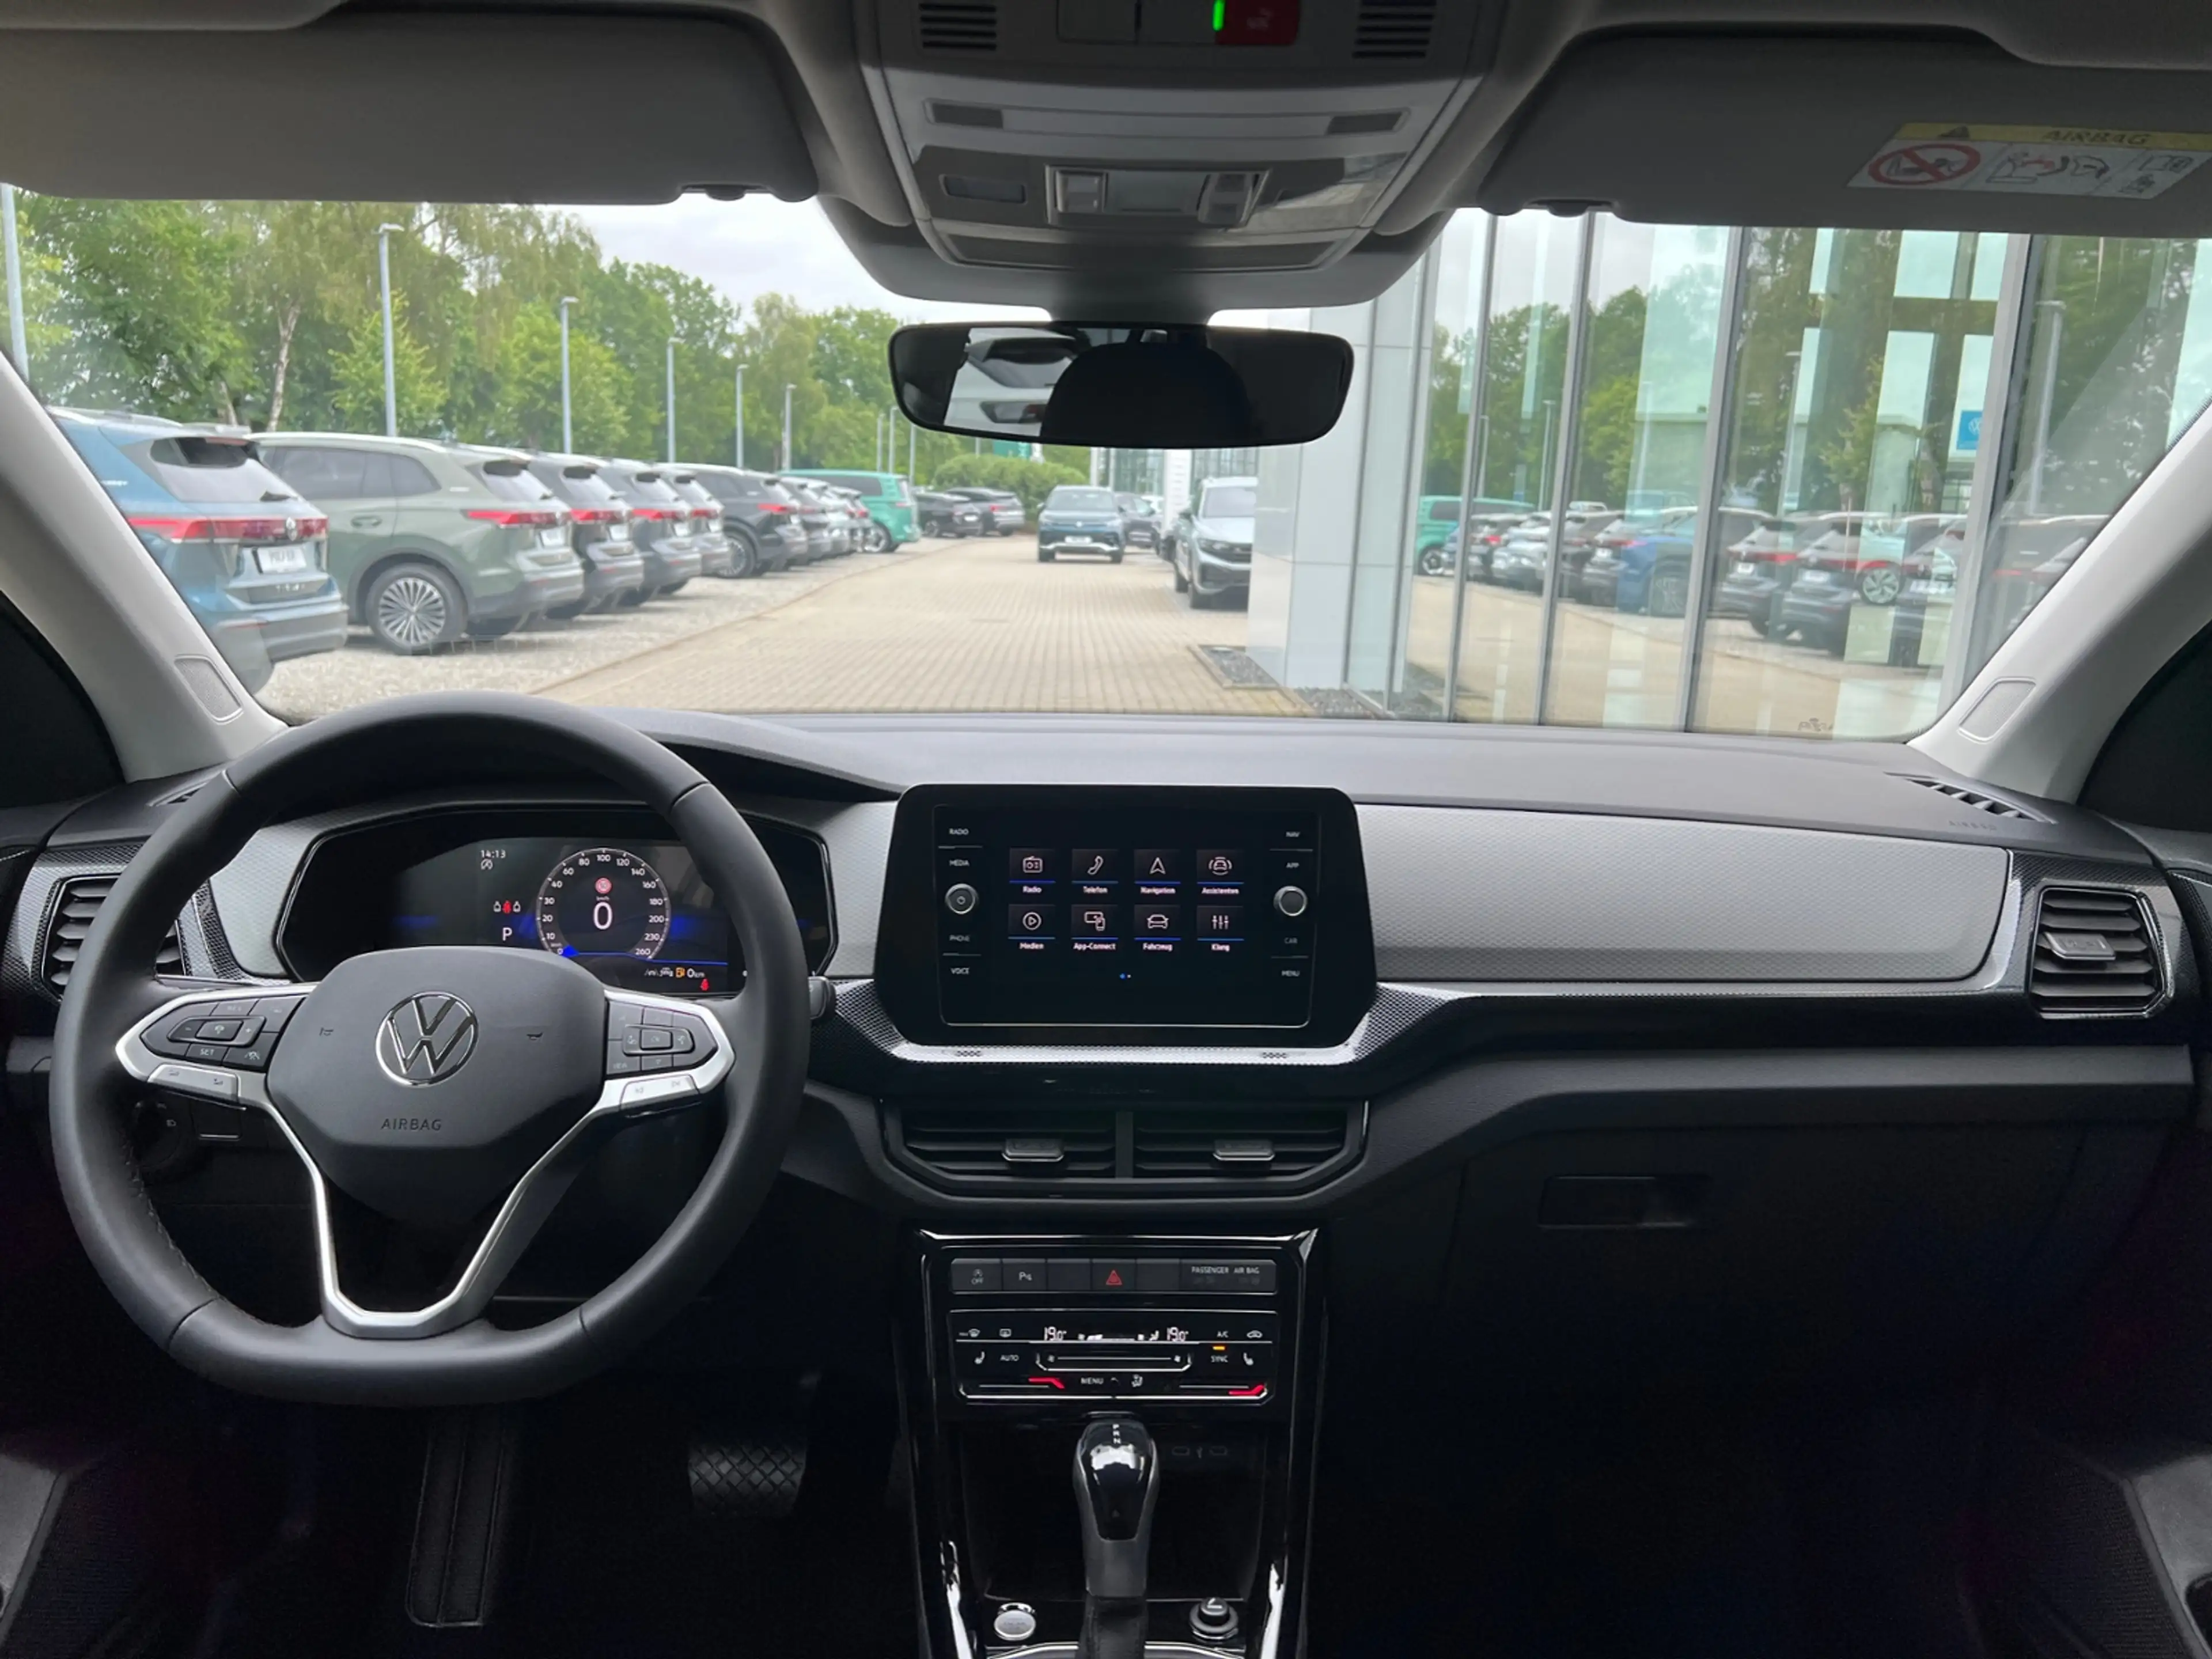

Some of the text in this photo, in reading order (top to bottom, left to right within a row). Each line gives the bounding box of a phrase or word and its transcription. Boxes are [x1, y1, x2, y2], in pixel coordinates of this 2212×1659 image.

[2042, 130, 2152, 145] AIRBAG
[480, 850, 506, 858] 14:13
[578, 858, 590, 866] 80
[616, 858, 630, 866] 120
[562, 867, 574, 876] 60
[631, 868, 645, 876] 140
[551, 880, 563, 888] 40
[642, 880, 656, 889] 160
[1083, 885, 1108, 893] Telefon
[1140, 887, 1176, 895] Navigation
[544, 897, 555, 905] 30
[649, 897, 662, 906] 180
[542, 914, 553, 922] 20
[593, 902, 612, 930] 0
[649, 915, 664, 923] 200
[502, 927, 513, 941] P
[546, 932, 555, 940] 10
[644, 933, 660, 941] 230
[1073, 942, 1116, 950] App-Connect
[1143, 942, 1173, 952] Fahrzeug
[1211, 944, 1230, 952] Klang
[200, 1048, 214, 1056] SET
[381, 1118, 442, 1131] AIRBAG
[1191, 1266, 1229, 1274] PASSENGER
[1211, 1355, 1228, 1363] SYNC
